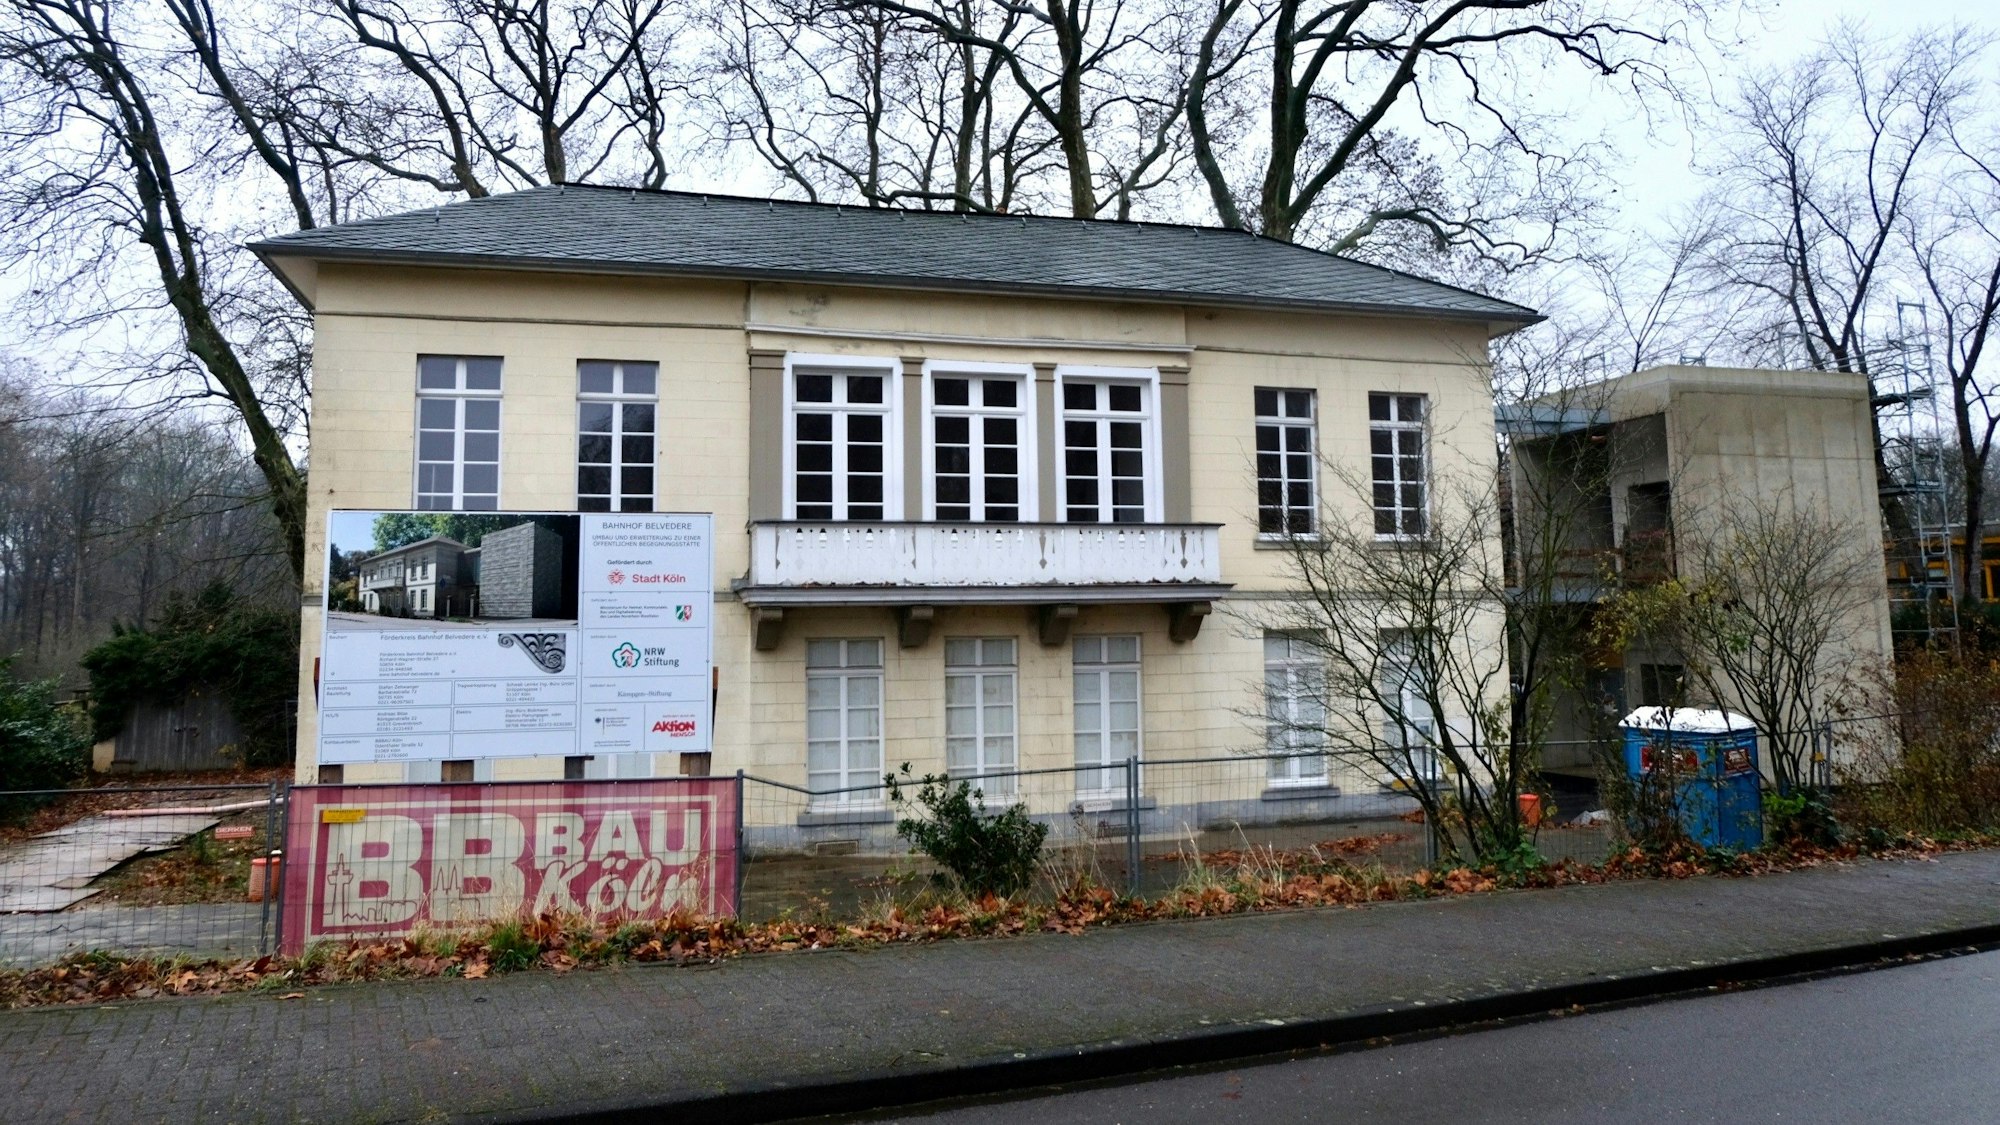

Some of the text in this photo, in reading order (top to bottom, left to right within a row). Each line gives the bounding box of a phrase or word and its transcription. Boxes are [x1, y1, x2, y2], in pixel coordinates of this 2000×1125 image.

[602, 522, 692, 530] BAHNHOF BELVEDERE
[632, 574, 685, 583] Stadt Köln
[644, 648, 665, 656] NRW
[644, 658, 679, 668] Stiftung
[534, 809, 702, 868] BAU
[322, 813, 525, 927] BB
[535, 856, 700, 917] Köln
